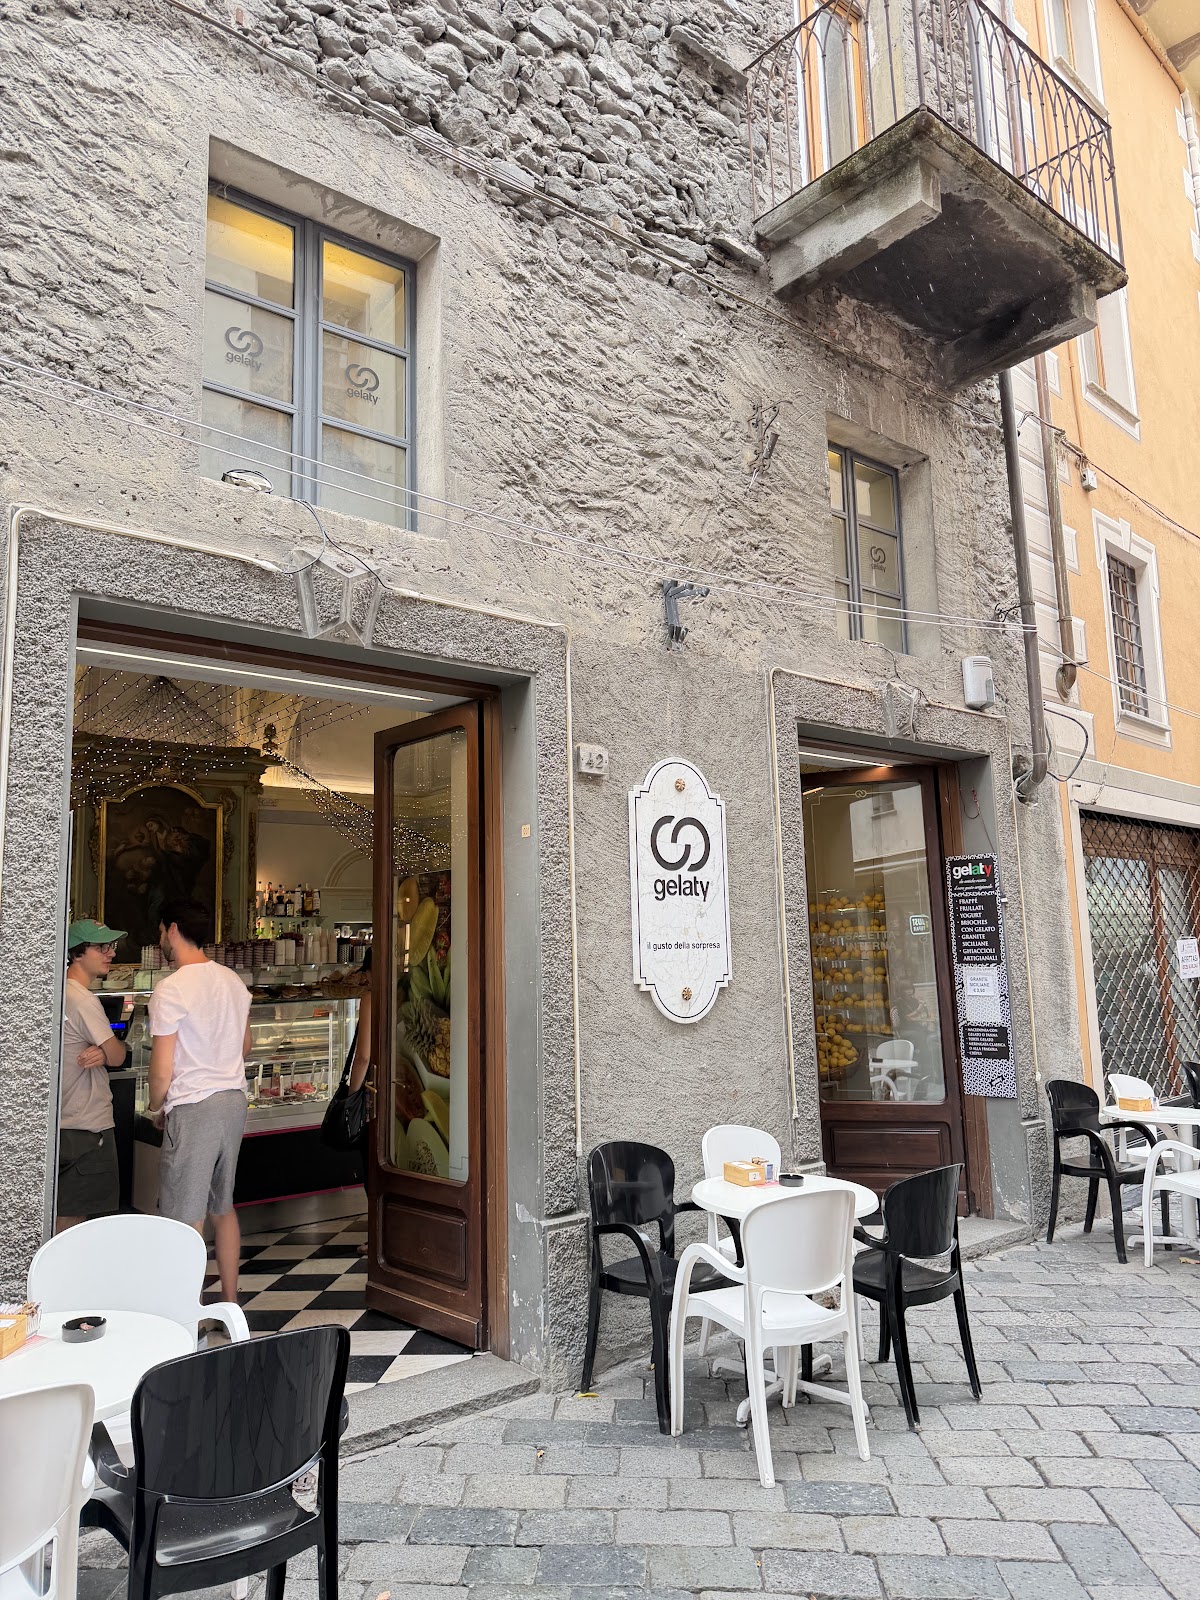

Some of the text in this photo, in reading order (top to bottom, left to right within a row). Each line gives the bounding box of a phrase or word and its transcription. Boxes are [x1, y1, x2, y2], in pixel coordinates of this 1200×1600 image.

[226, 350, 262, 371] gelaty
[346, 388, 378, 405] gelaty
[585, 751, 604, 769] 42
[952, 862, 992, 879] gelaty
[653, 873, 710, 903] gelaty
[646, 941, 721, 951] il gusto della sorpresa
